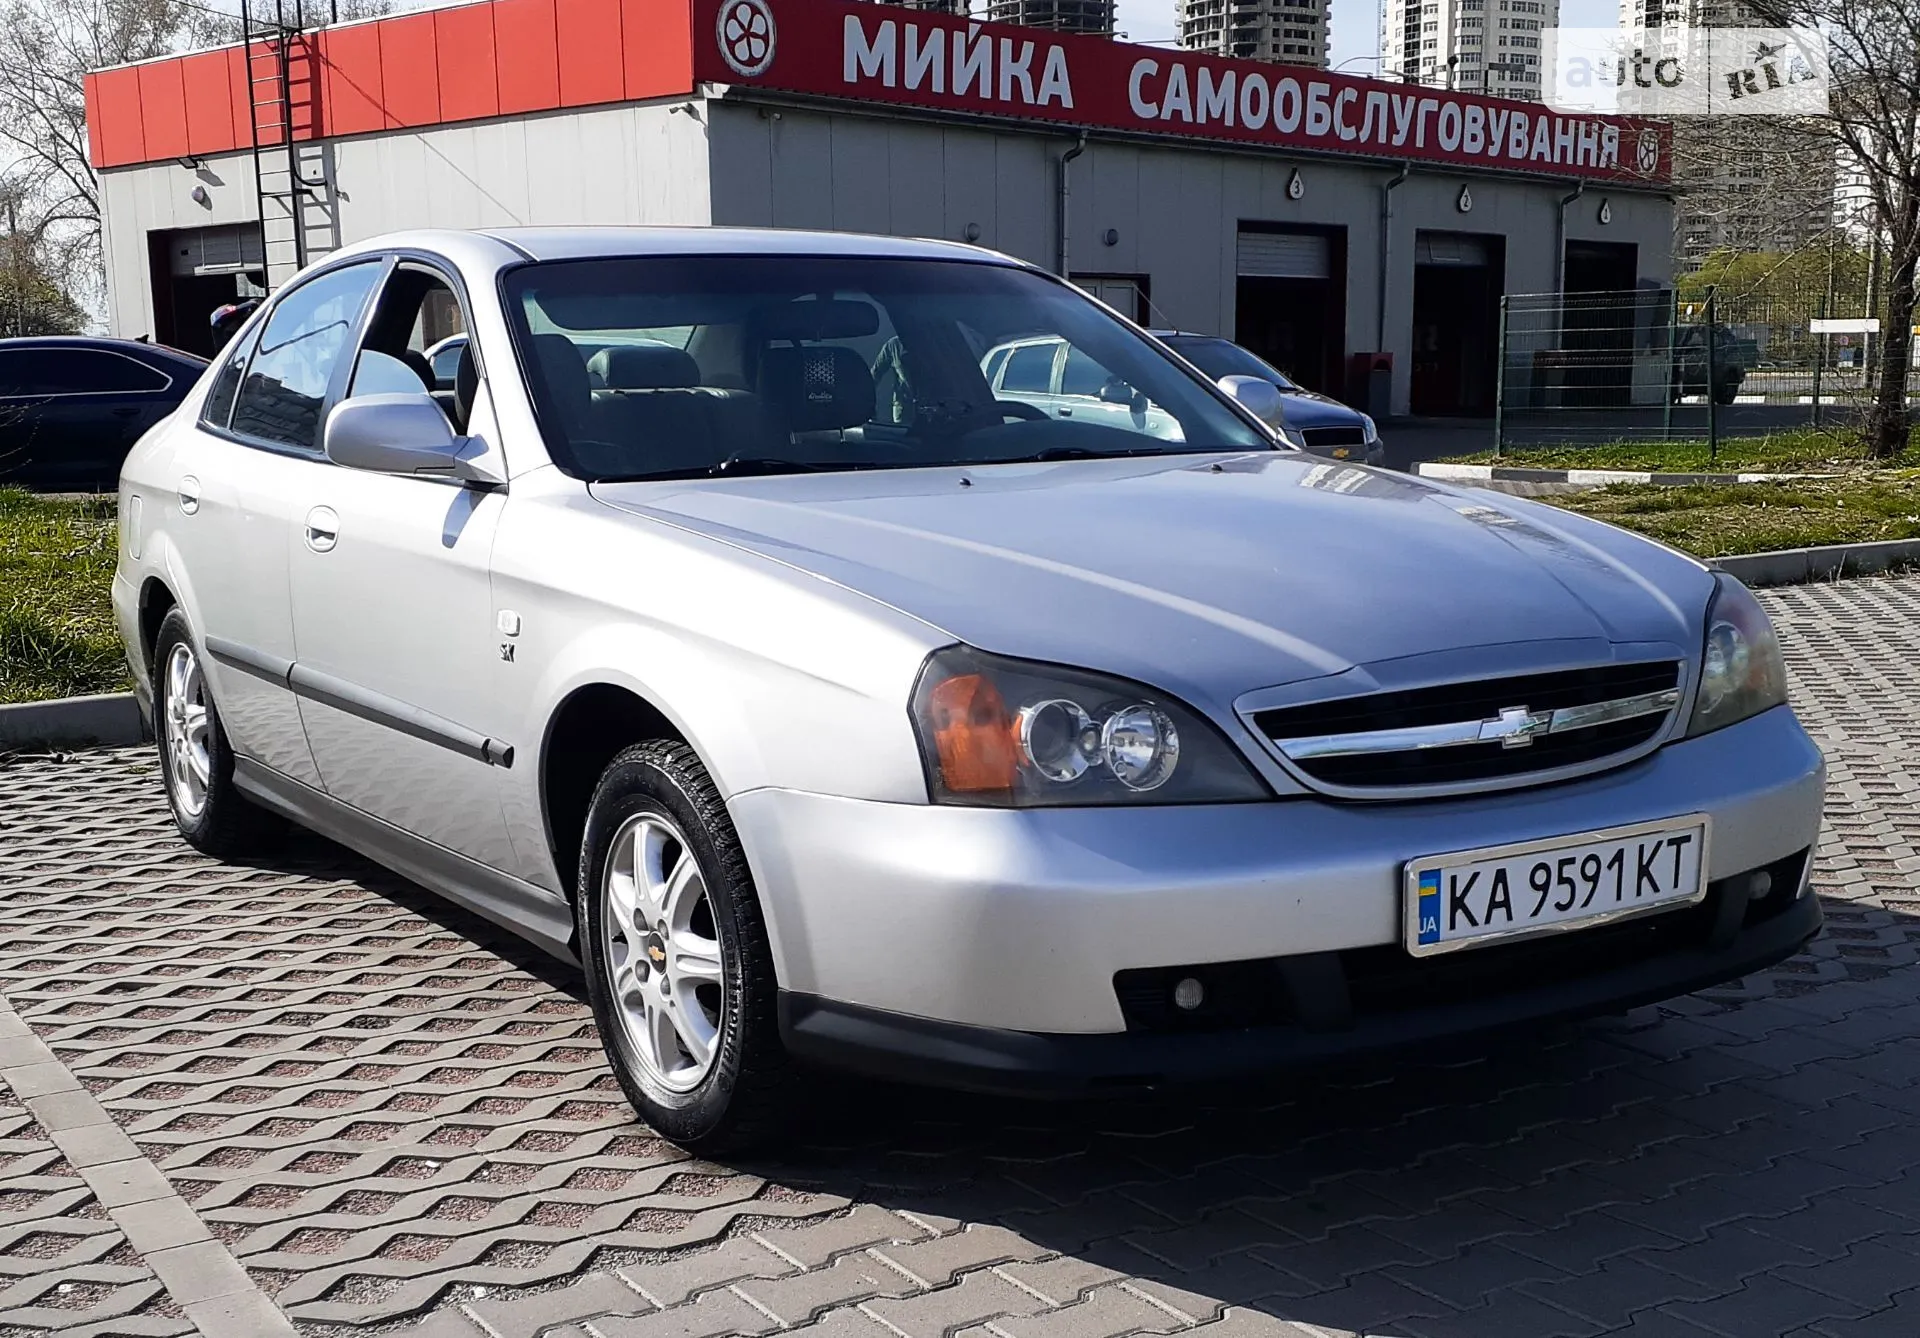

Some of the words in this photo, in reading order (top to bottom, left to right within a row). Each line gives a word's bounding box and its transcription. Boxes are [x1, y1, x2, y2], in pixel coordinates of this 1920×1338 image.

[843, 15, 1073, 109] МИЙКА
[1128, 58, 1619, 169] САМООБСЛУГОВУВАННЯ
[1419, 916, 1437, 934] UA
[1449, 868, 1513, 930] KA
[1529, 848, 1624, 917] 9591
[1635, 835, 1692, 897] KT
